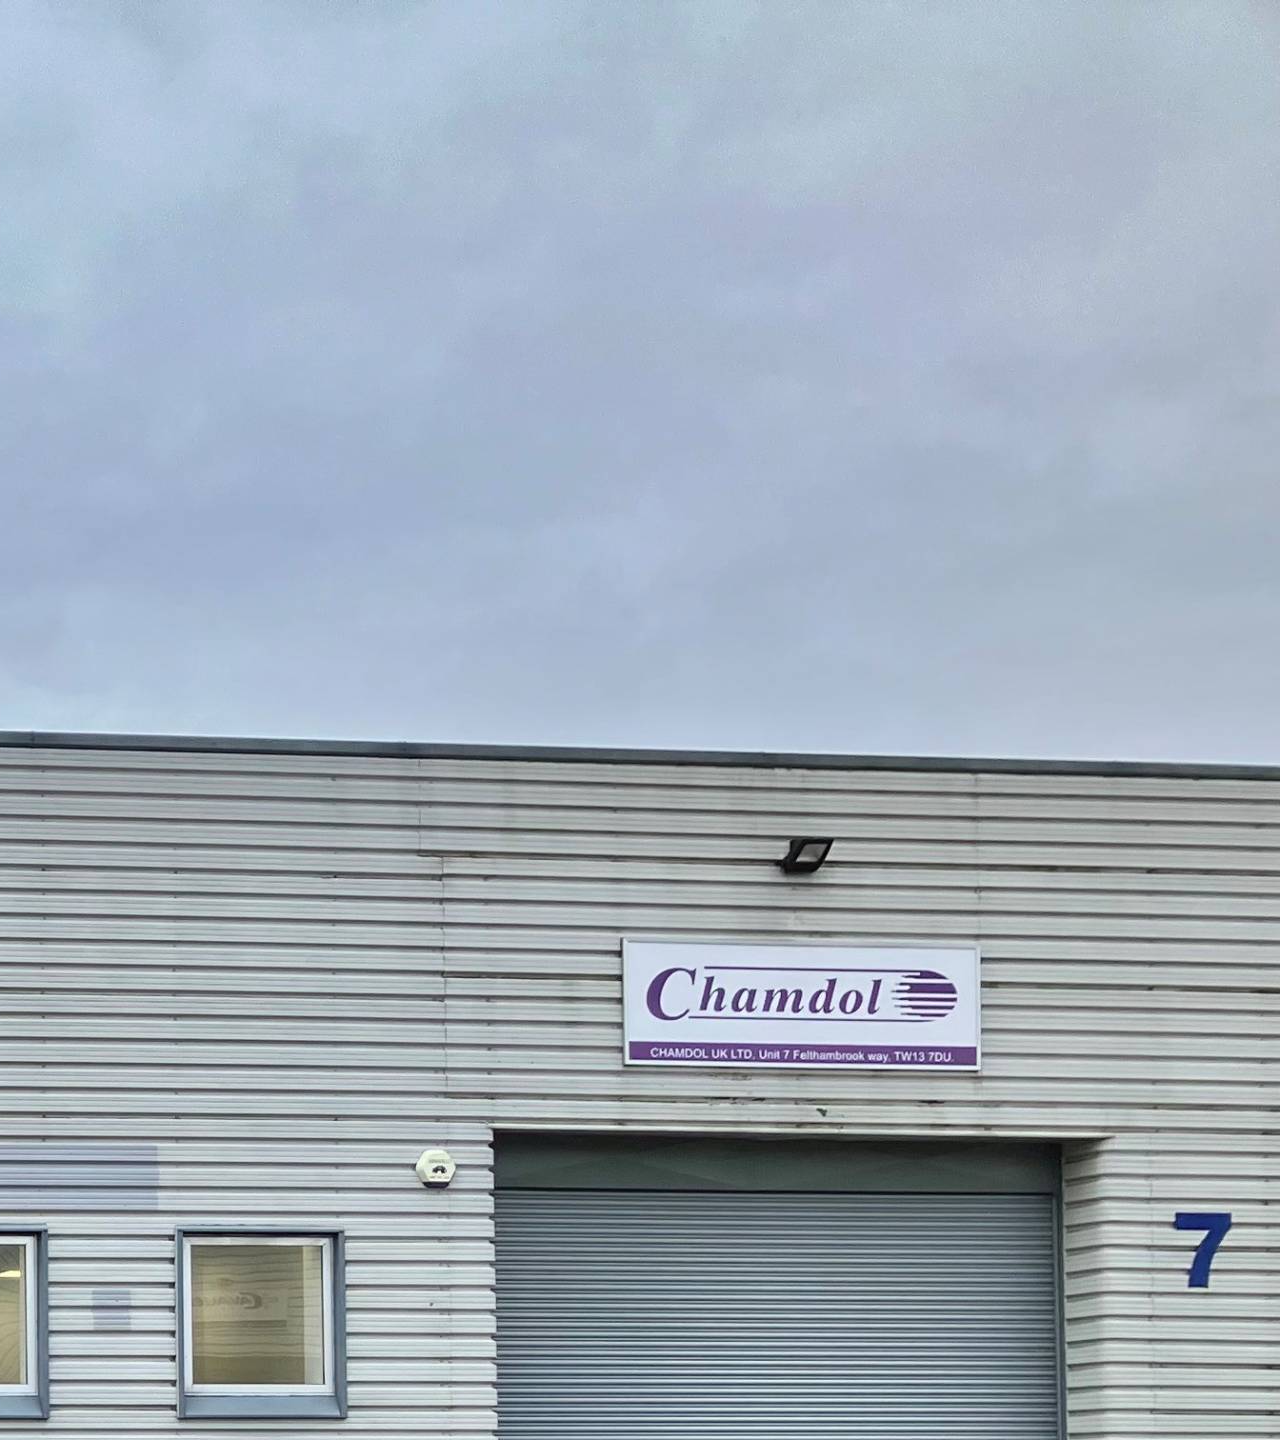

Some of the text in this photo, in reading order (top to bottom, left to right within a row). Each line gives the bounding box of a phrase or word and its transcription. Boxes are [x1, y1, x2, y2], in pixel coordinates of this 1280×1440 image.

[646, 967, 882, 1021] Chamdol
[650, 1048, 708, 1058] CHAMDOL
[711, 1049, 728, 1059] UK
[759, 1050, 780, 1060] Unit
[783, 1050, 790, 1060] 7
[793, 1050, 865, 1061] Felthambrook
[894, 1051, 925, 1062] TW13
[1175, 1212, 1232, 1288] 7
